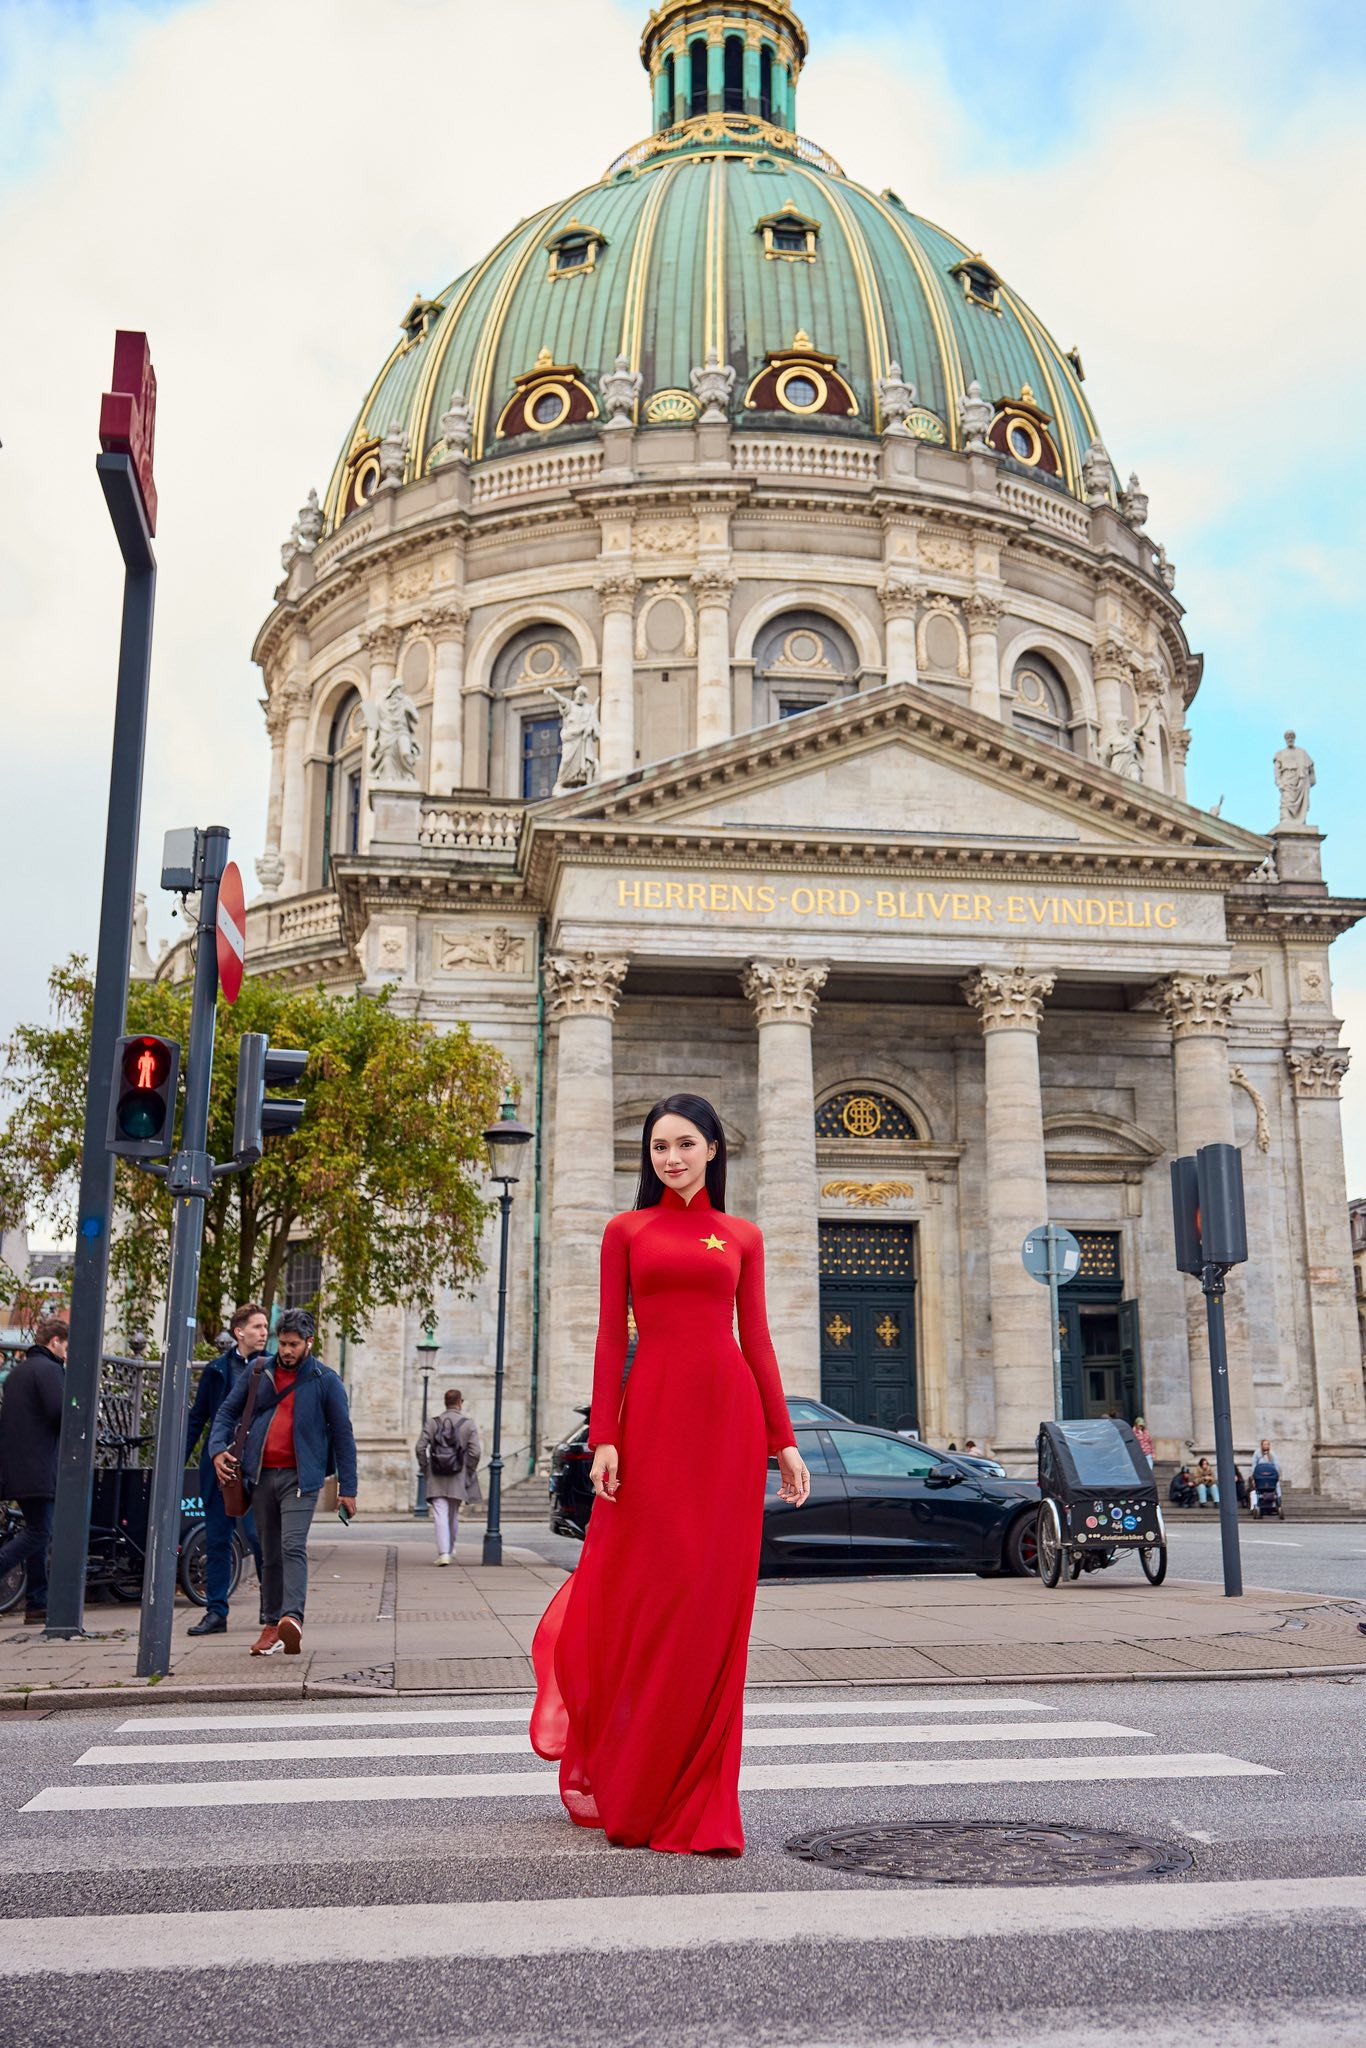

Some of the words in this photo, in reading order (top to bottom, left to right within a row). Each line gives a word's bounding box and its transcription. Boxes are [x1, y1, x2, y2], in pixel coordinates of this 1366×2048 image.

[617, 879, 776, 913] HERRENS
[790, 887, 861, 917] ORD
[875, 890, 994, 922] BLIVER
[1007, 895, 1178, 929] EVINDELIG
